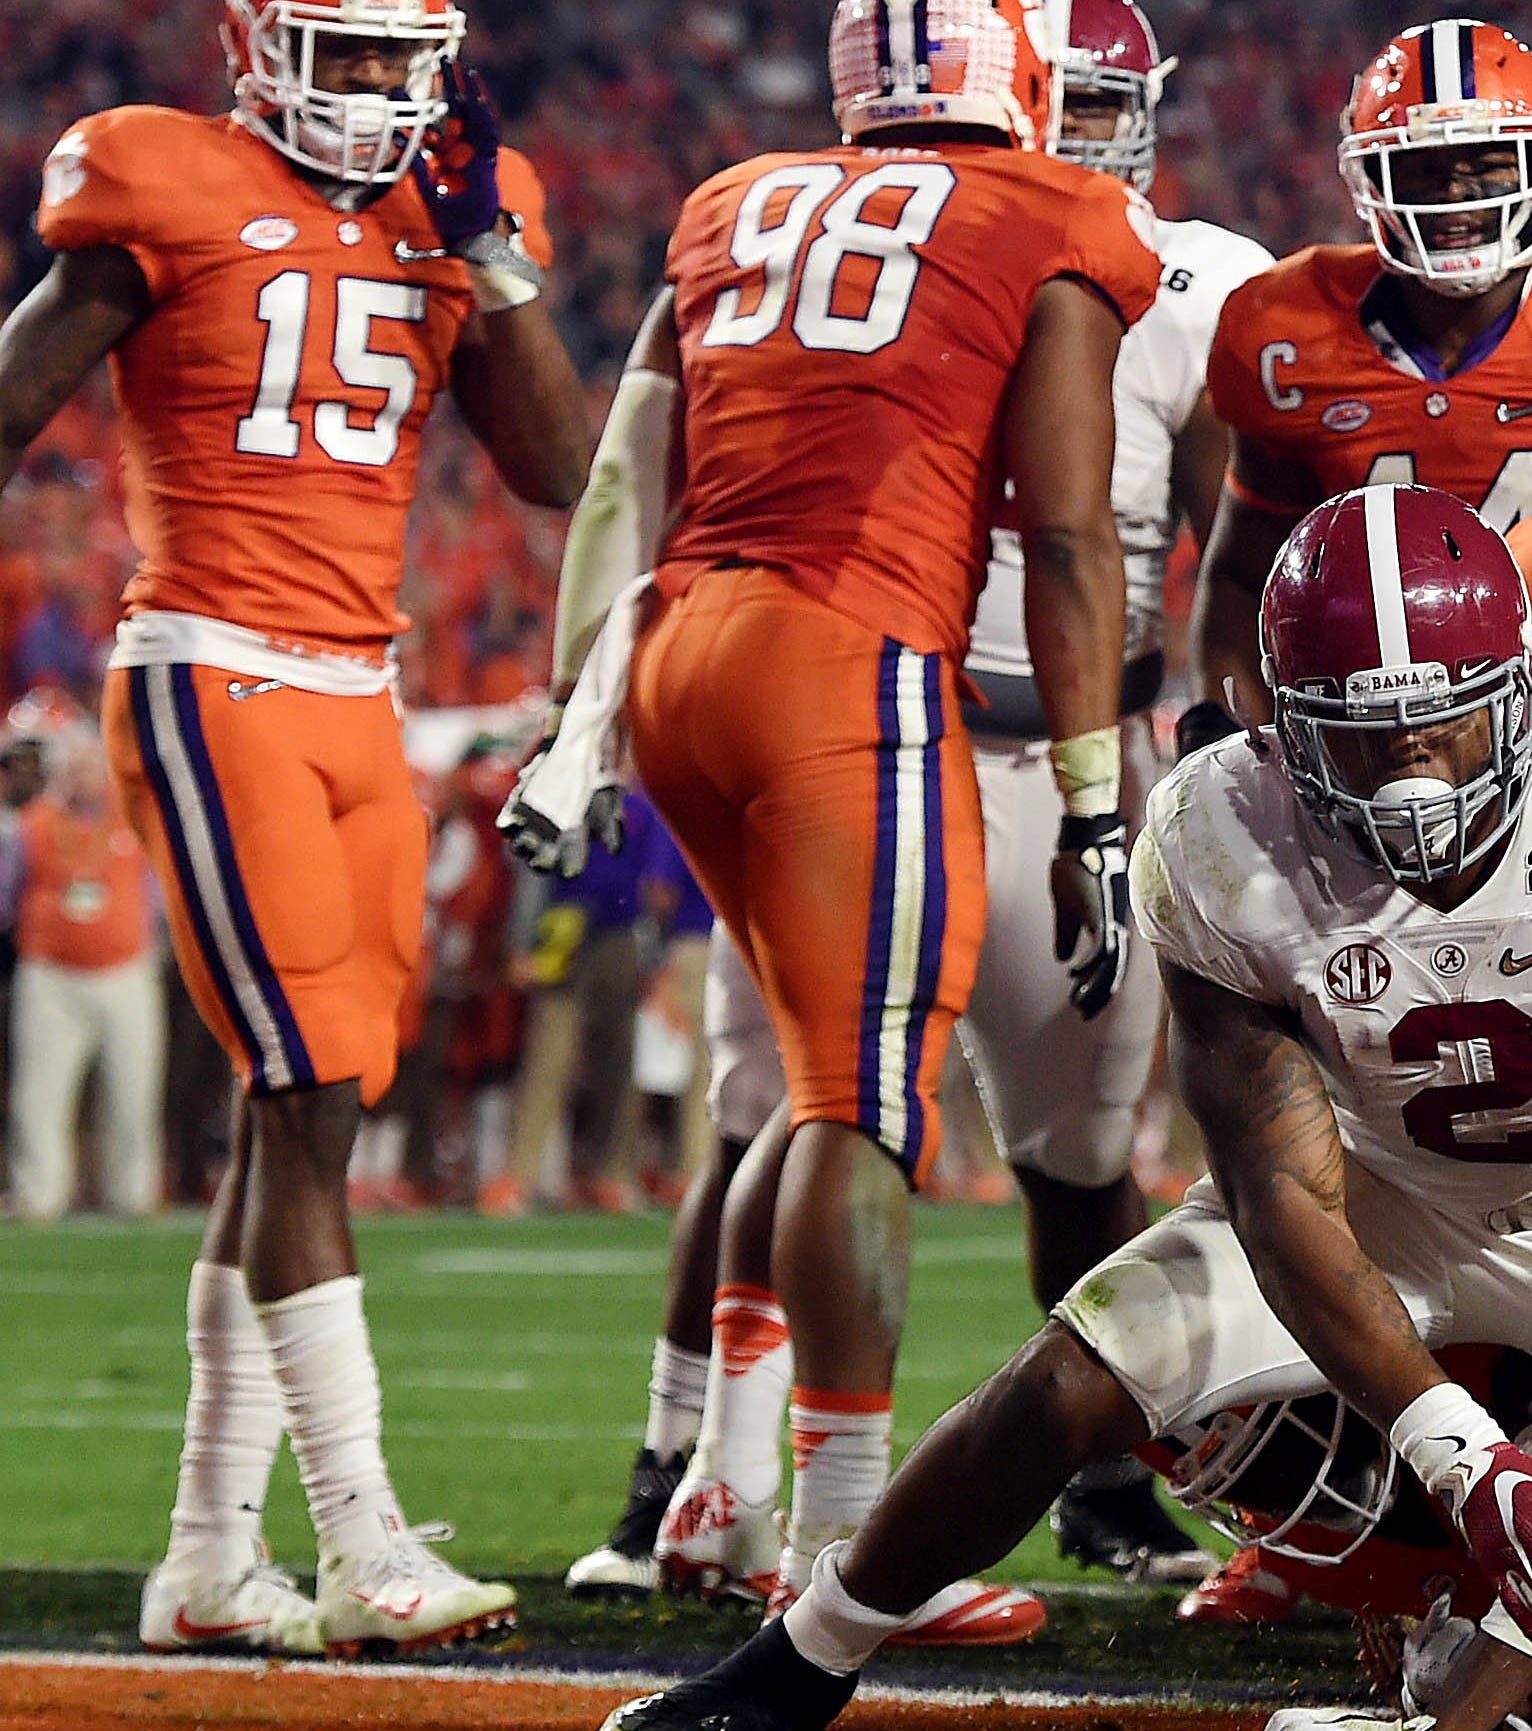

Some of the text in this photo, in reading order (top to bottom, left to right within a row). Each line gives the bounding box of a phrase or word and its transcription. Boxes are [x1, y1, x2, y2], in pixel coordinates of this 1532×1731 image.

[701, 163, 957, 354] 98
[236, 269, 428, 467] 15
[1260, 340, 1303, 411] C
[1372, 671, 1421, 691] BAMA
[1330, 948, 1388, 1001] SEC
